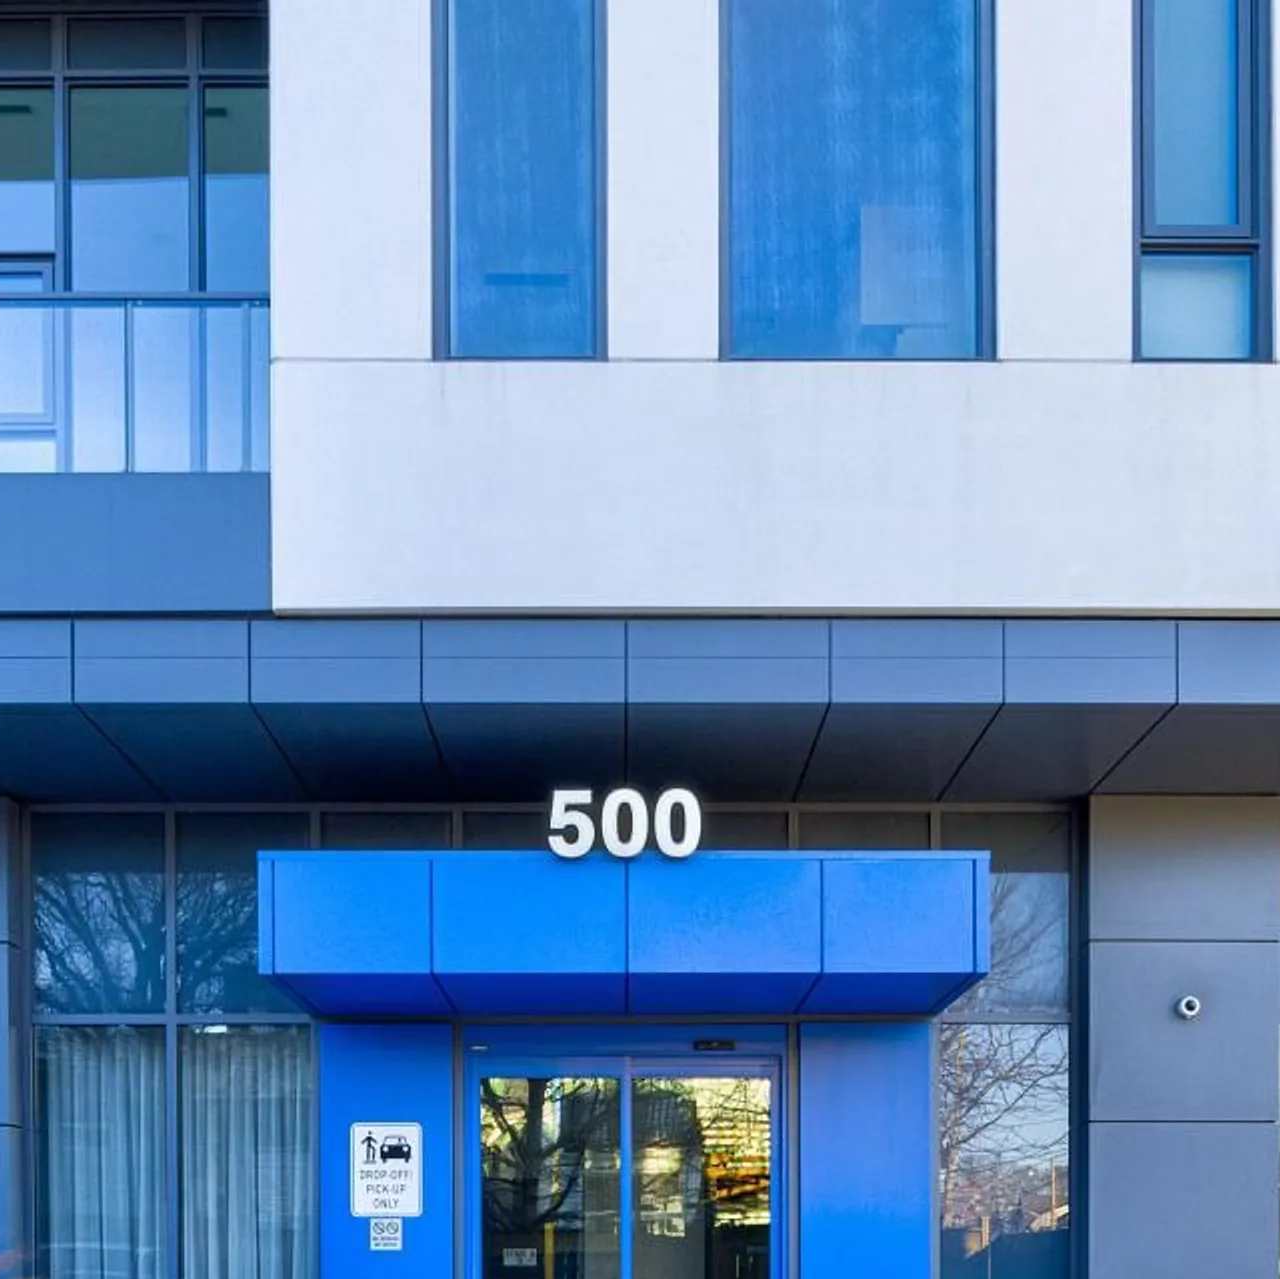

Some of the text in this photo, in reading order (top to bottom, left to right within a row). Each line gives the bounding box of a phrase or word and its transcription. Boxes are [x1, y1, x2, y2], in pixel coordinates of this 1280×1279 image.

[547, 788, 702, 858] 500
[366, 1184, 406, 1195] PICK-UP
[373, 1198, 399, 1209] ONLY
